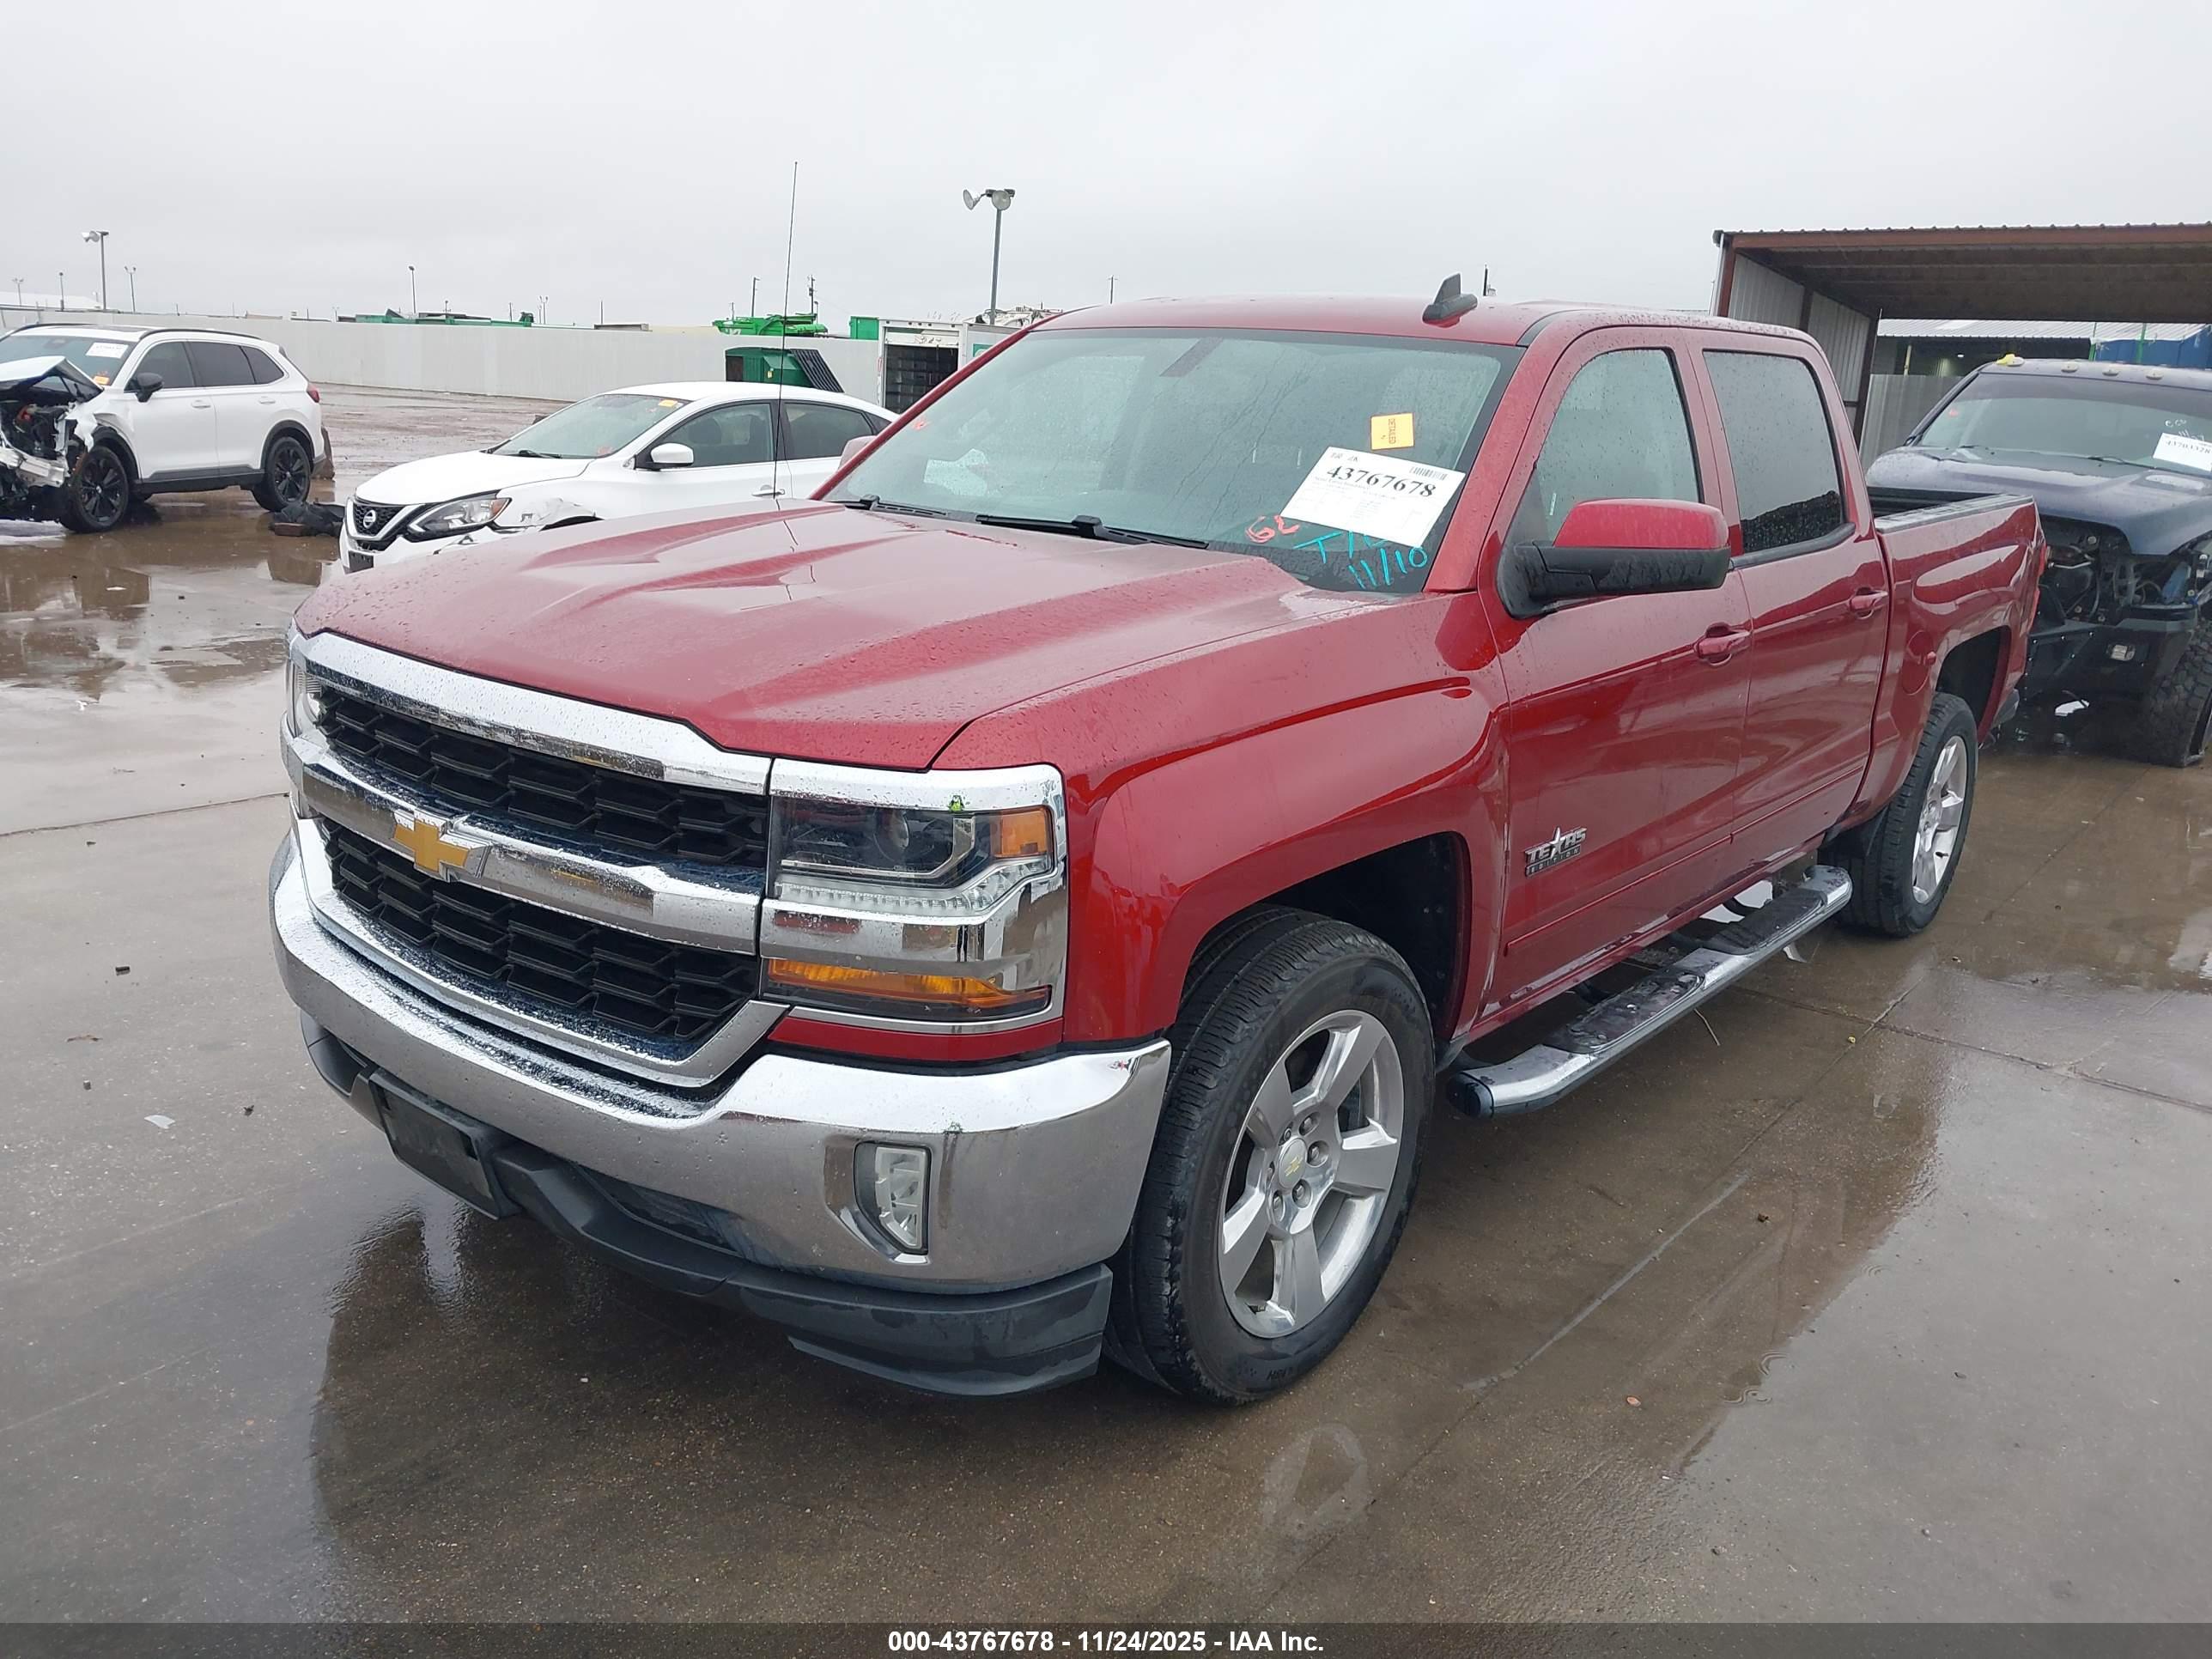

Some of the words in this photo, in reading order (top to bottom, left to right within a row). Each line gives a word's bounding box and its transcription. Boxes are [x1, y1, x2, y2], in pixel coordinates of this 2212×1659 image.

[1327, 465, 1437, 497] 43767678
[1524, 827, 1587, 864] TEXAS
[1530, 848, 1579, 873] EDITION
